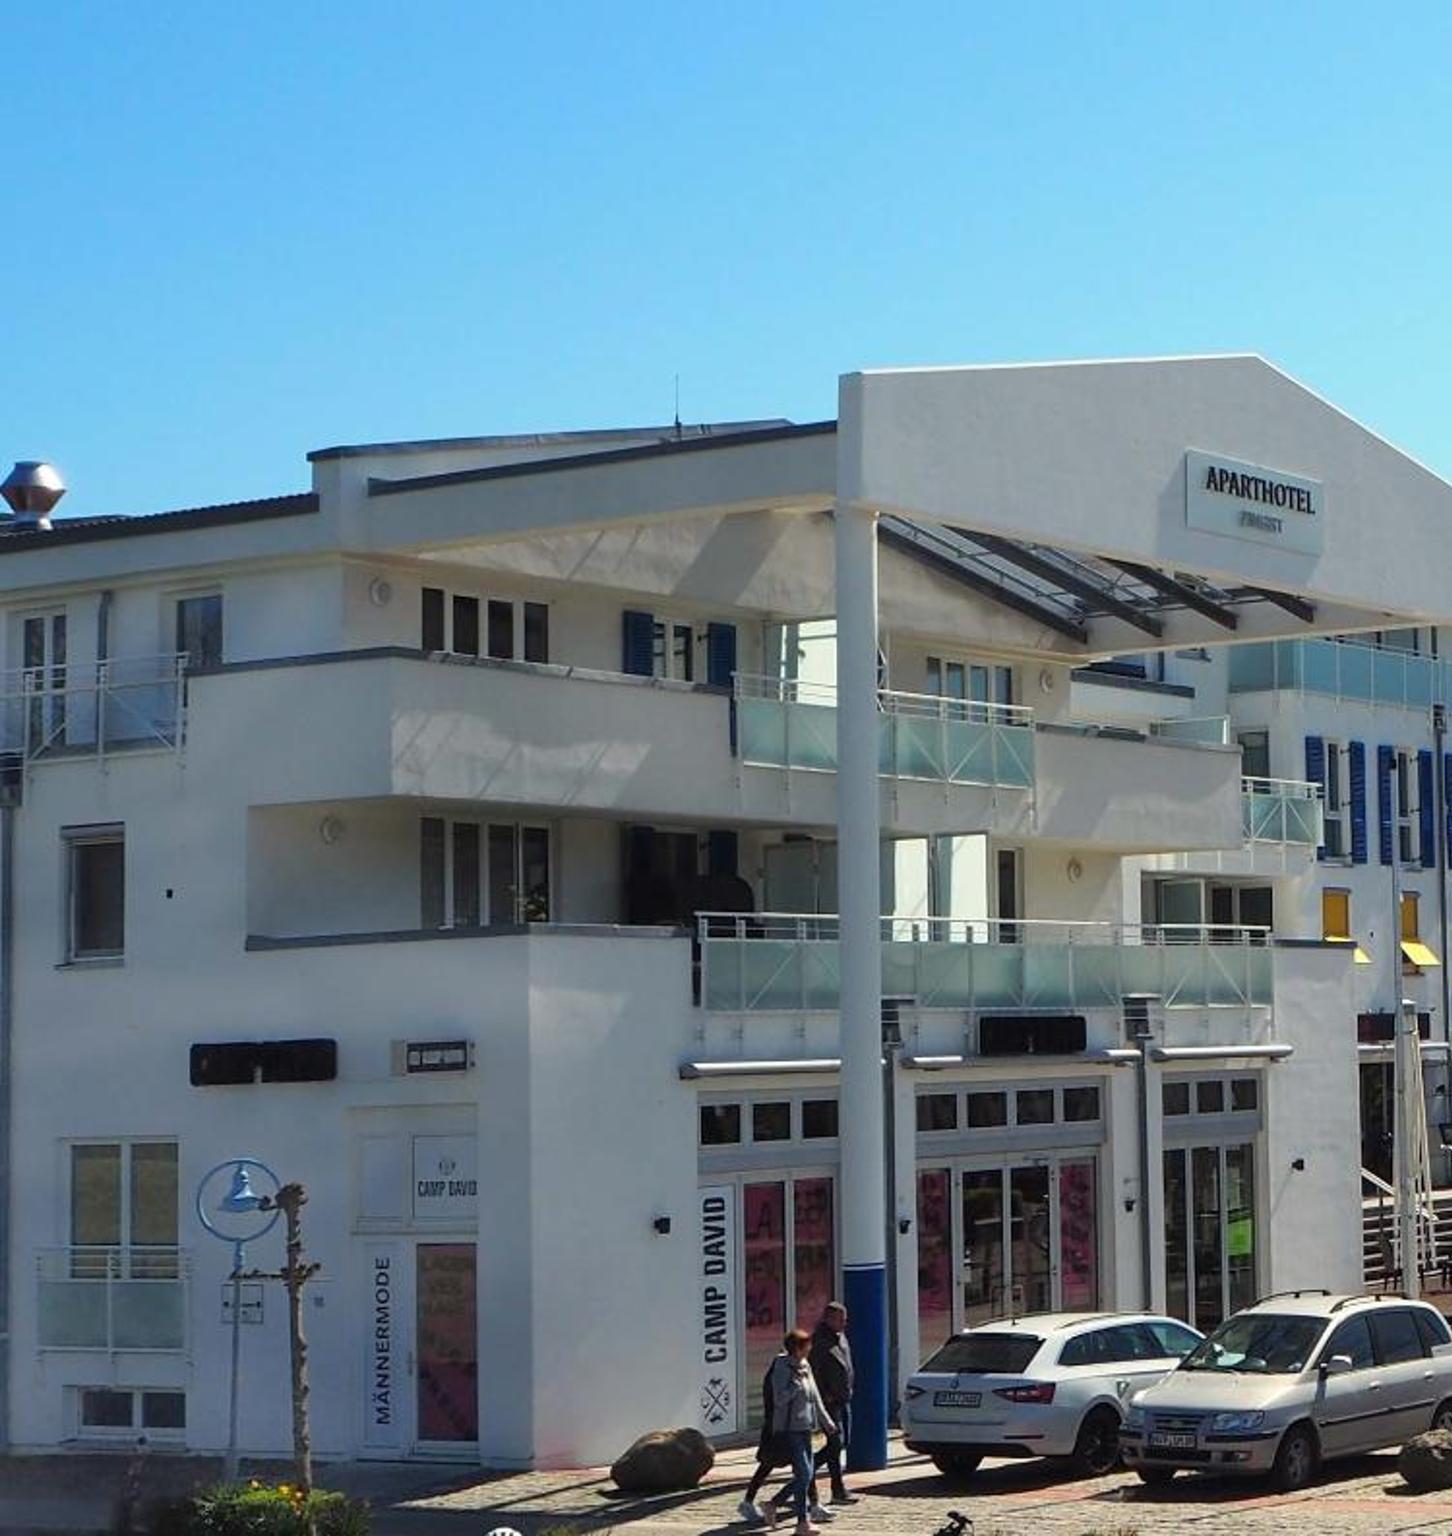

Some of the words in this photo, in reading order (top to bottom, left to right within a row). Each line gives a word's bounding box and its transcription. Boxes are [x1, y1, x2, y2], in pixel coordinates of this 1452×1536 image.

[1205, 465, 1316, 515] APARTHOTEL
[417, 1180, 446, 1198] CAMP
[703, 1196, 726, 1276] DAVID
[372, 1256, 391, 1425] MÄNNERMODE
[704, 1286, 727, 1364] CAMP
